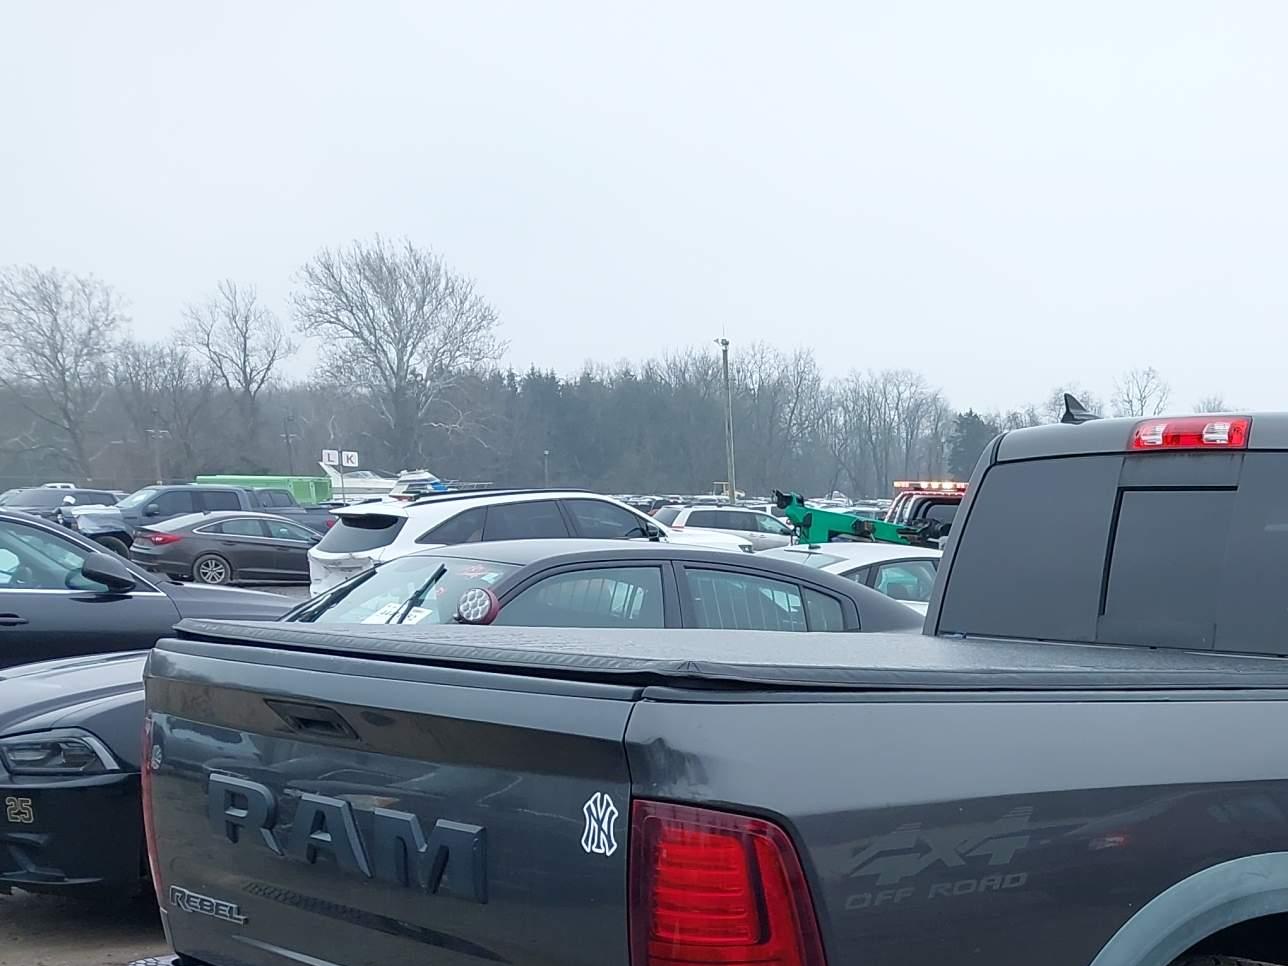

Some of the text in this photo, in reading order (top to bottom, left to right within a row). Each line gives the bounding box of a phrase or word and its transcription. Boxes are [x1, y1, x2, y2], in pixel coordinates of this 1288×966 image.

[327, 452, 335, 463] L
[346, 453, 355, 465] K
[5, 796, 34, 824] 25
[580, 791, 619, 857] NY
[207, 772, 489, 905] RAM
[169, 884, 249, 928] REBEL
[844, 872, 1028, 911] OFF ROAD
